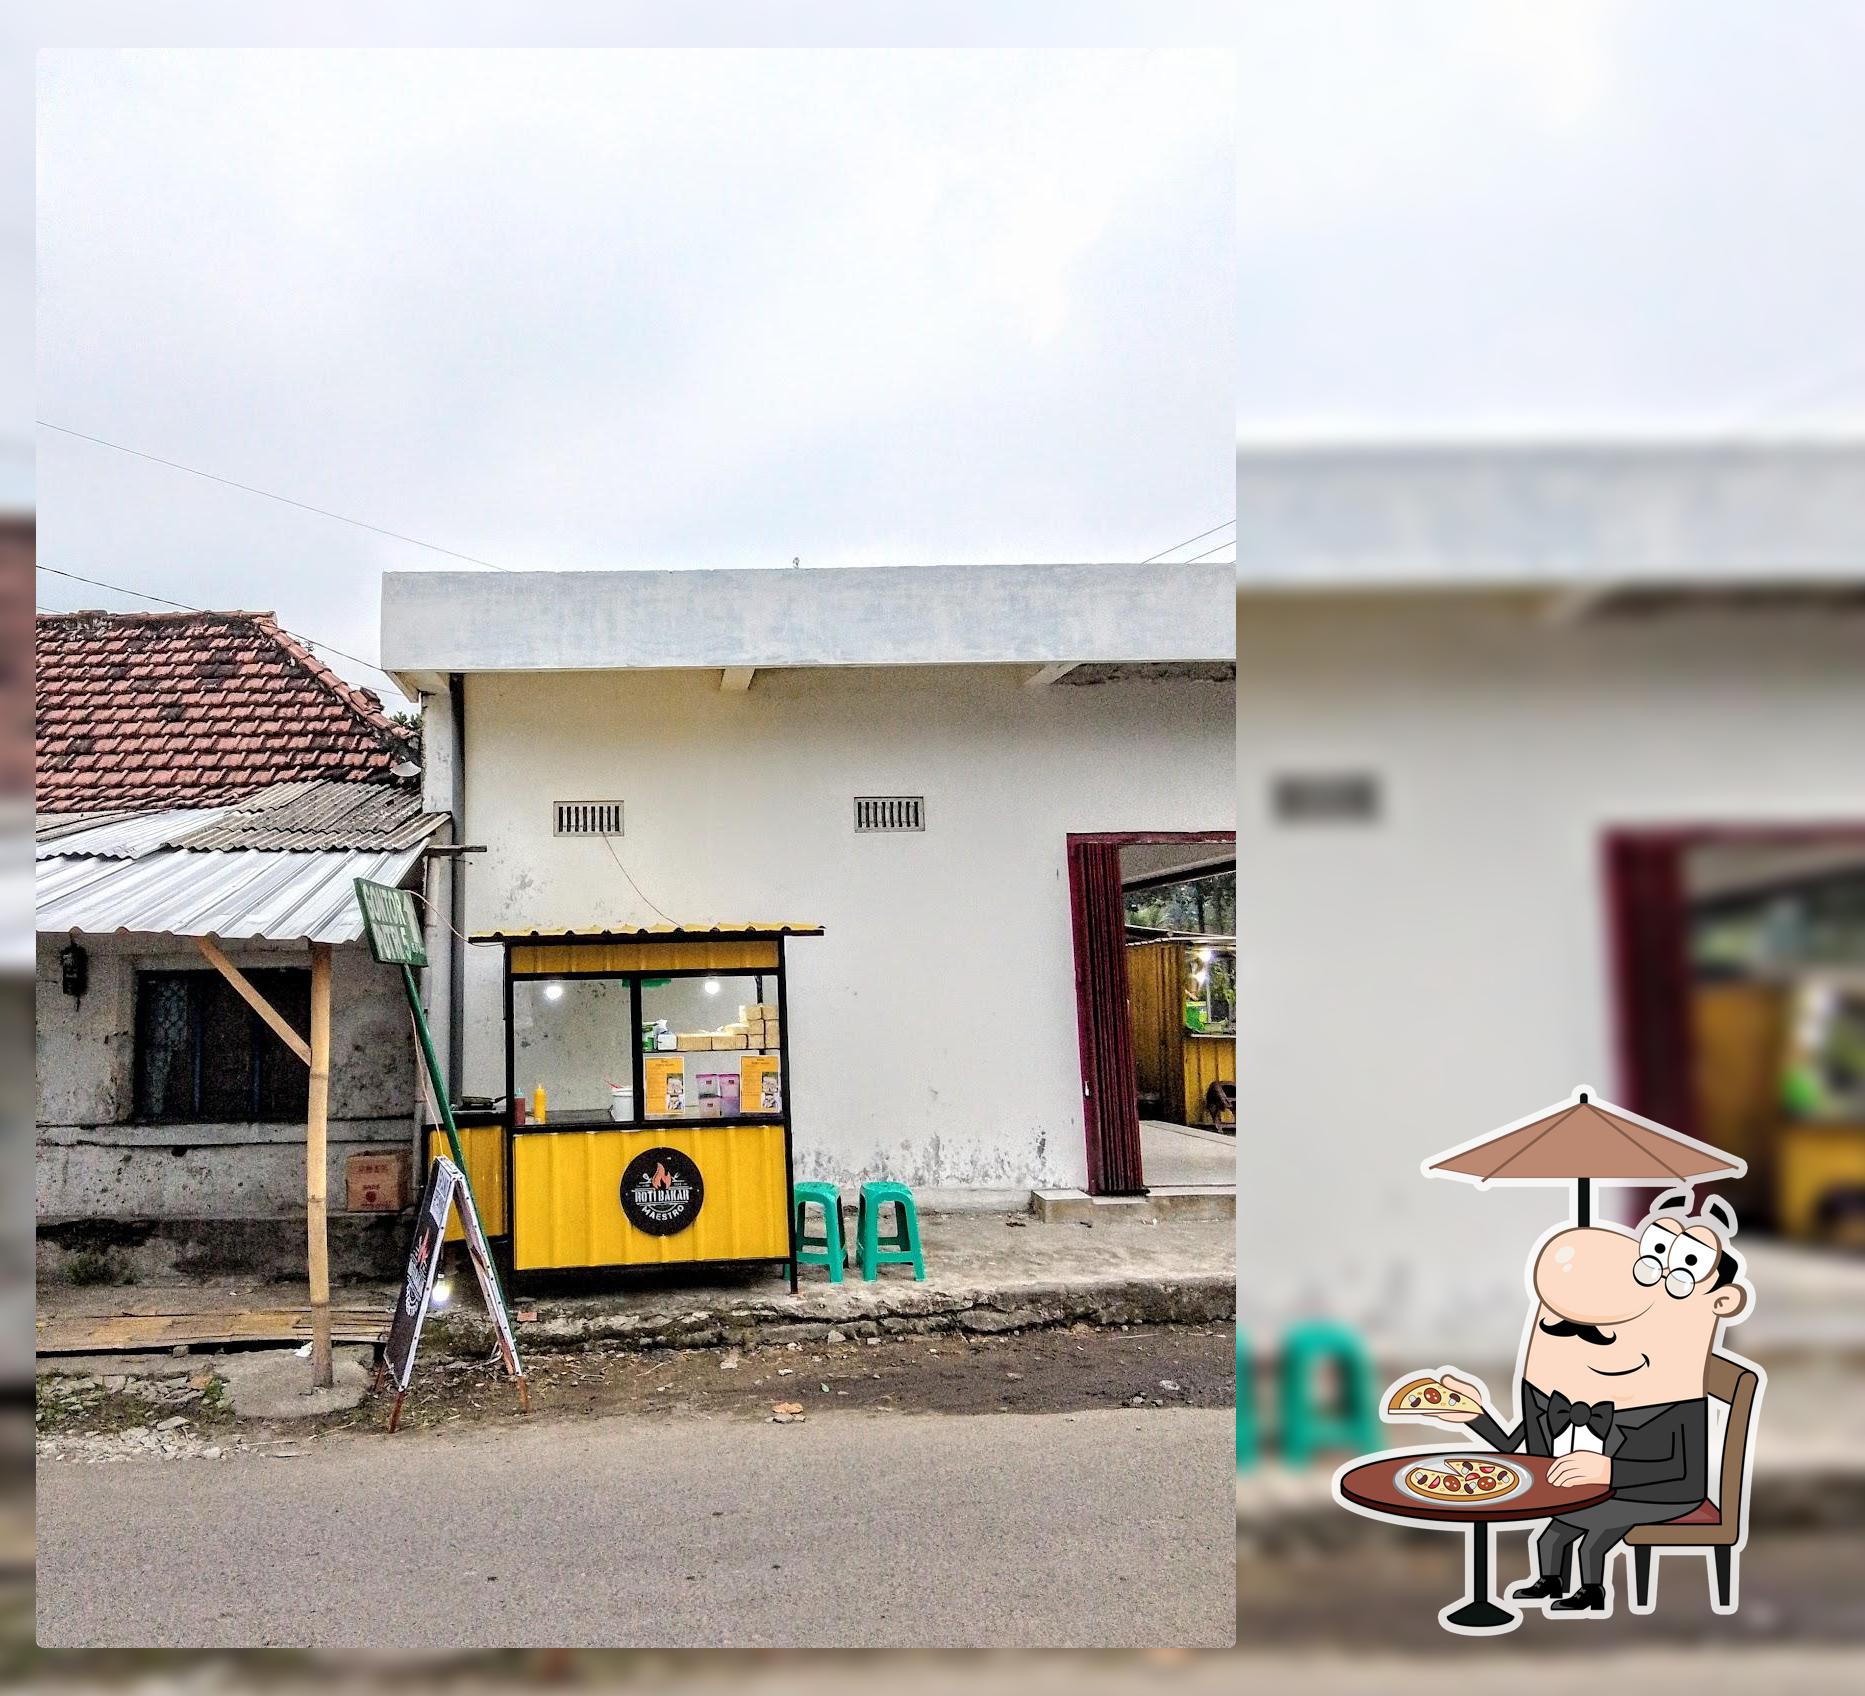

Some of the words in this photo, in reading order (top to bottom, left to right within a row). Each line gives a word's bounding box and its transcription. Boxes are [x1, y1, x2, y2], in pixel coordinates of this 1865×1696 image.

[361, 883, 407, 925] GONTOR
[634, 1190, 656, 1202] ROTI
[658, 1189, 690, 1202] BAKAR
[641, 1205, 684, 1220] MAESTRO
